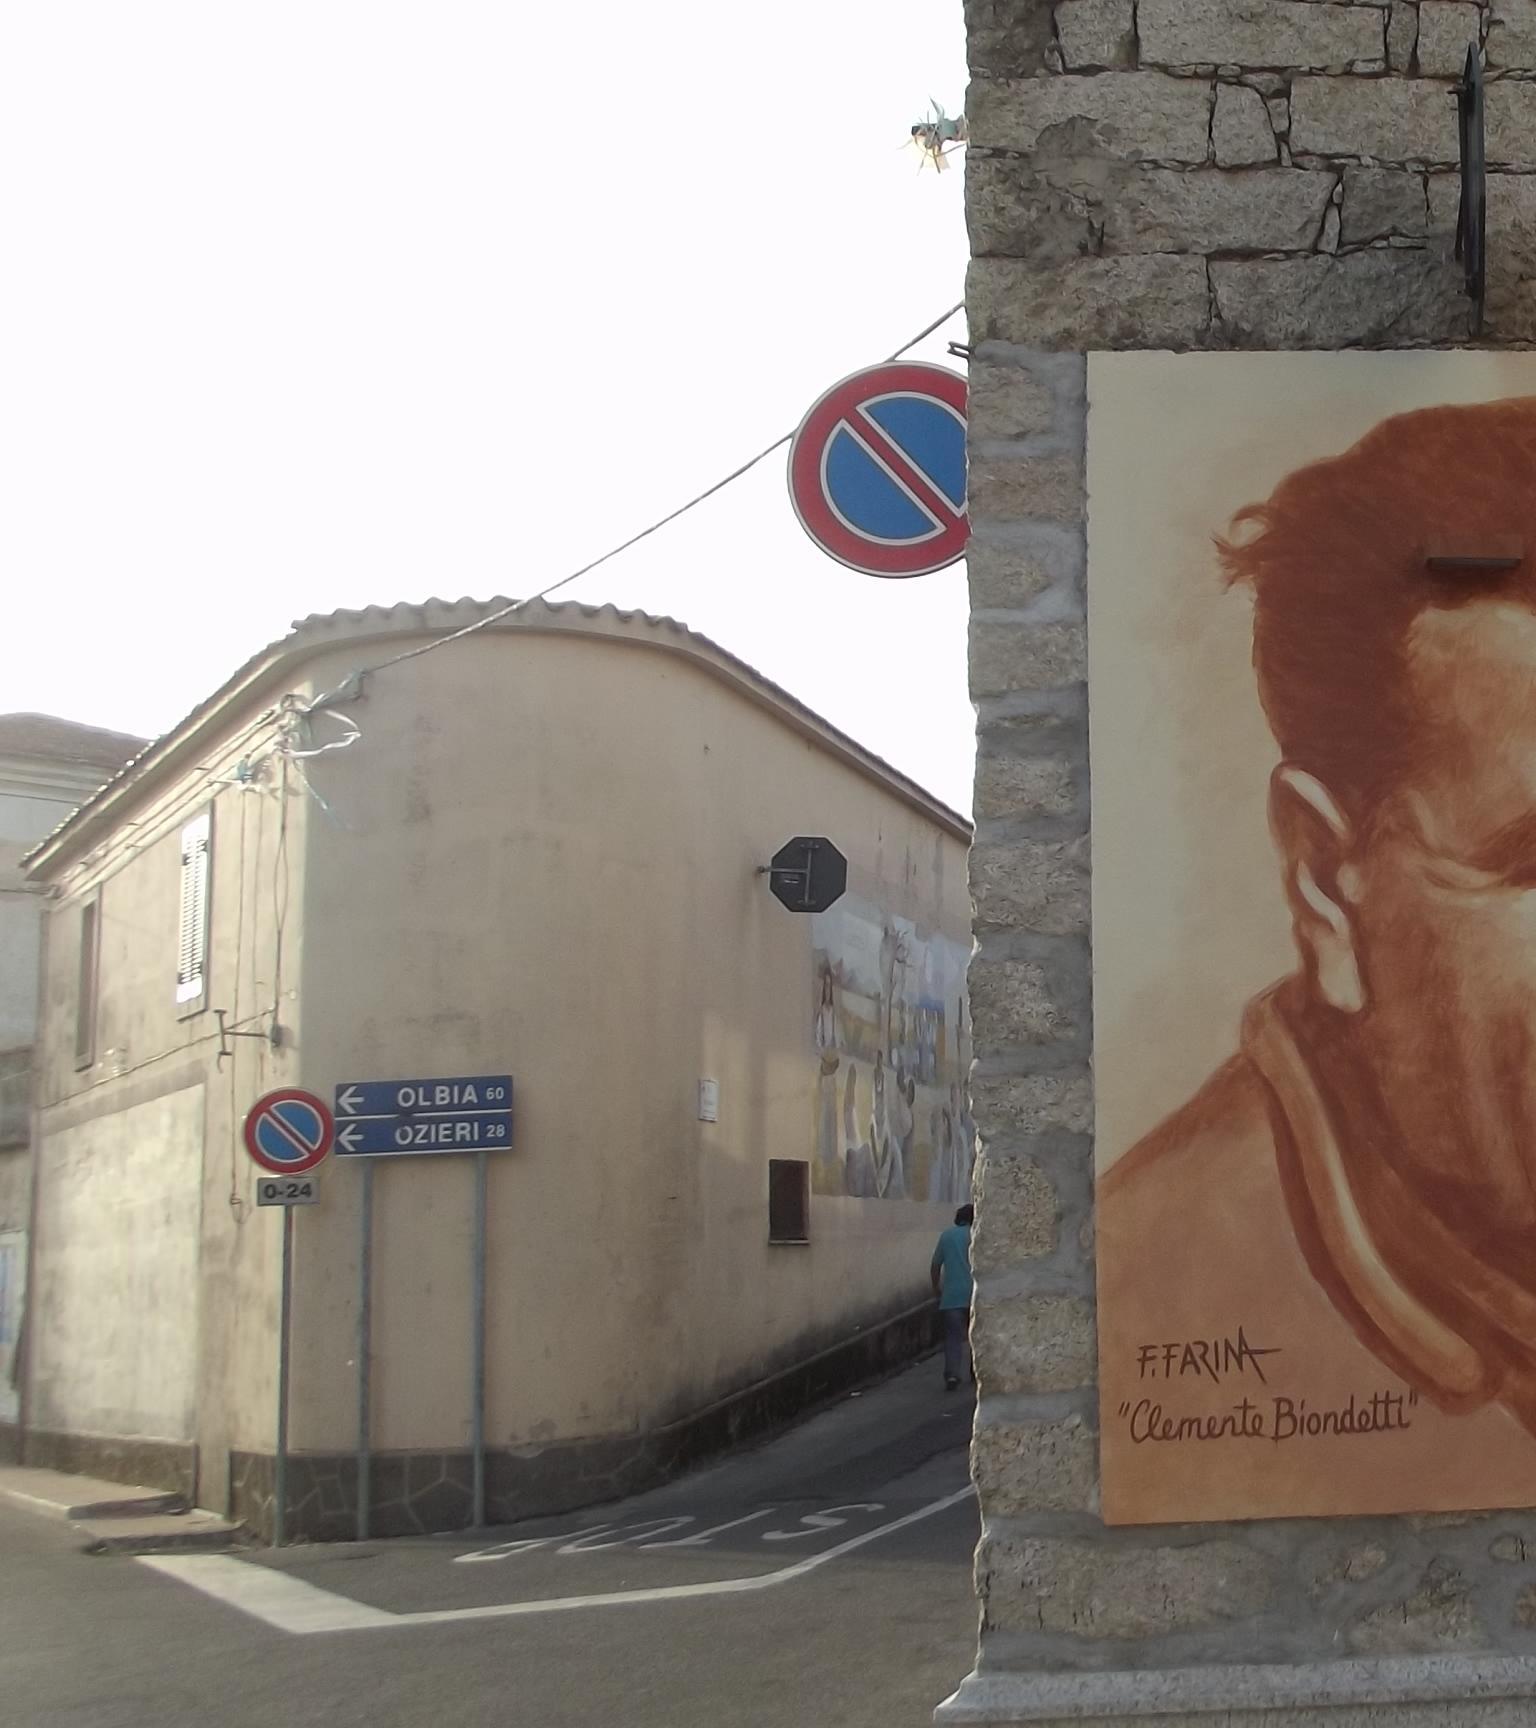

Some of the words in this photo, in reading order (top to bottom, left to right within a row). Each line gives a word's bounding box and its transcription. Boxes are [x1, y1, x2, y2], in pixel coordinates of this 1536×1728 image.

[397, 1084, 478, 1107] OLBIA
[486, 1086, 505, 1100] 60
[394, 1121, 479, 1145] OZIERI
[486, 1124, 505, 1138] 28
[263, 1182, 312, 1199] 0-24
